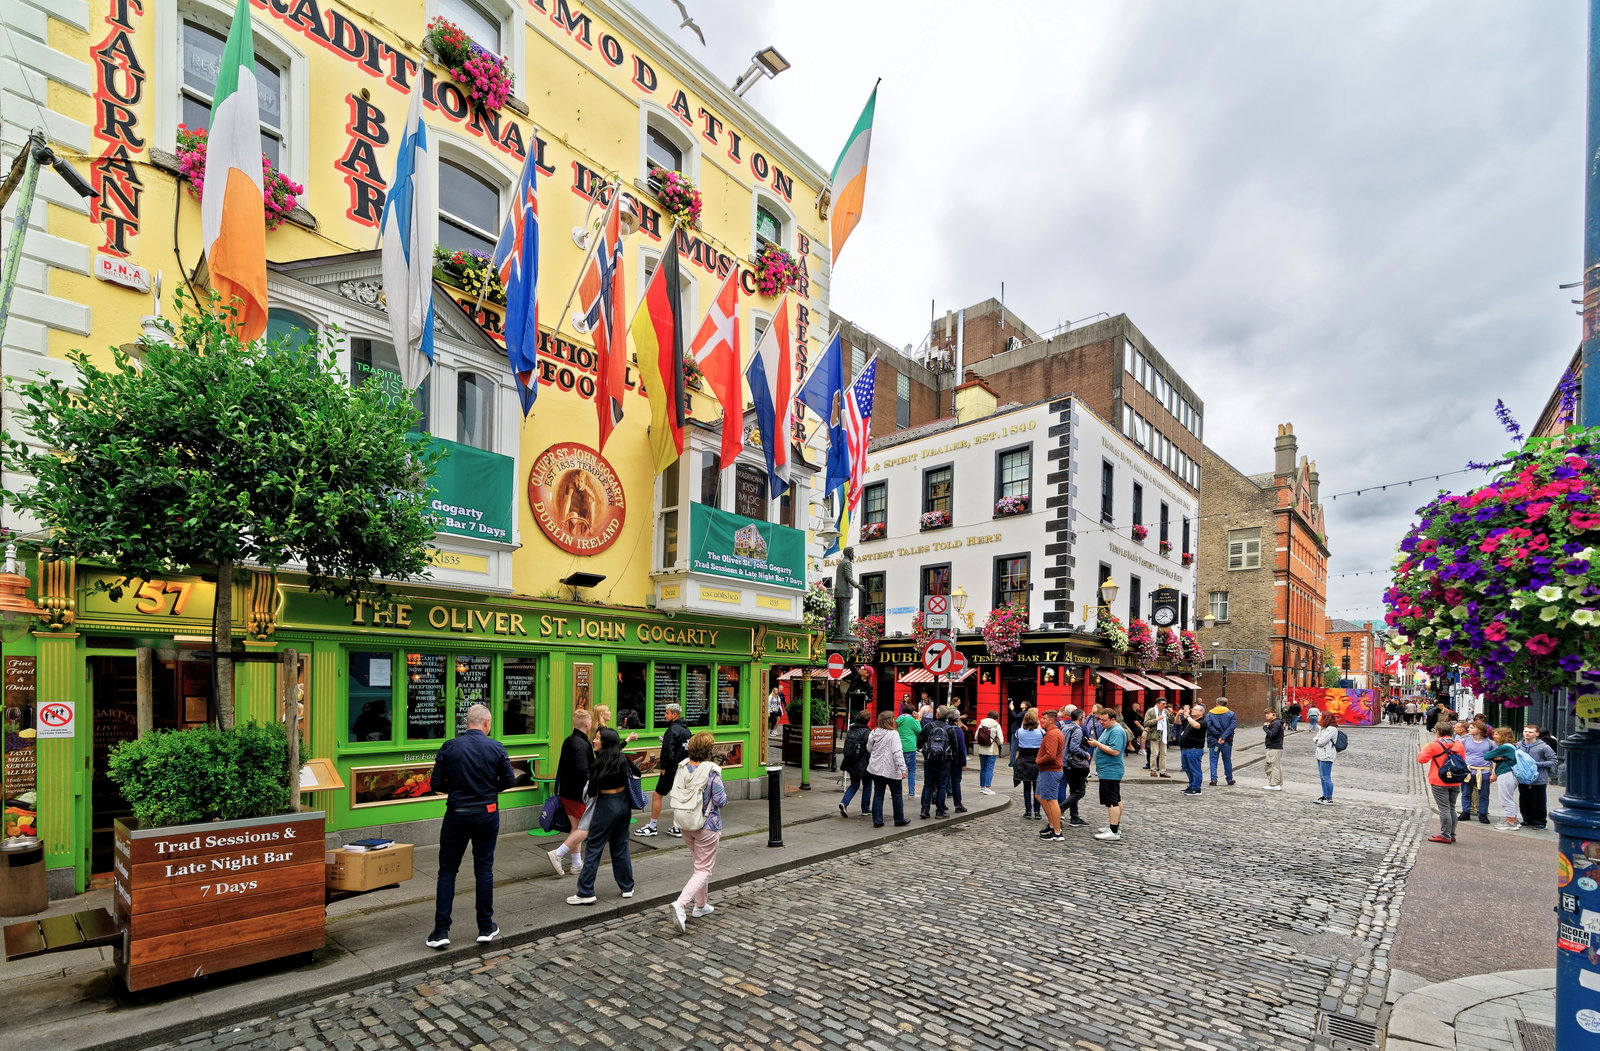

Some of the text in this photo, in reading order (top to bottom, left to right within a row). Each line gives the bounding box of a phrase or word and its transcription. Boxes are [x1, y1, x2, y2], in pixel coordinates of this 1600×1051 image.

[336, 93, 390, 228] BAR
[796, 233, 809, 300] BAR
[538, 359, 596, 400] FOO
[883, 453, 918, 468] SPIRIT
[531, 448, 624, 508] OLIVER ST JOHN GOGARTY
[545, 460, 614, 507] EST 1835 TEMPLE BAR
[743, 483, 758, 493] IRISH
[431, 500, 483, 521] Gogarty
[738, 493, 760, 507] MUSIC
[742, 505, 757, 516] BAR
[446, 517, 466, 529] Bar
[469, 521, 476, 531] 7
[479, 523, 506, 537] Days
[534, 502, 619, 550] DUBLIN IRELAND
[897, 544, 931, 557] TALES
[932, 539, 963, 551] TOLD
[966, 534, 1002, 547] HERE
[441, 556, 460, 565] 1835
[707, 551, 792, 575] The Oliver St. John Gogarty
[694, 560, 709, 569] Trad
[711, 562, 737, 574] Sessions
[744, 570, 757, 578] Late
[758, 571, 775, 581] Night
[790, 577, 802, 586] Days
[347, 598, 719, 647] THE OLIVER ST. JOHN GOGARTY
[775, 636, 800, 652] BAR
[879, 651, 922, 663] DUBL
[1017, 654, 1040, 662] BAR
[1044, 651, 1059, 662] 17
[1113, 655, 1126, 666] THE
[155, 827, 297, 854] Trad Sessions &
[165, 850, 293, 878] Late Night Bar
[200, 878, 258, 898] 7 Days
